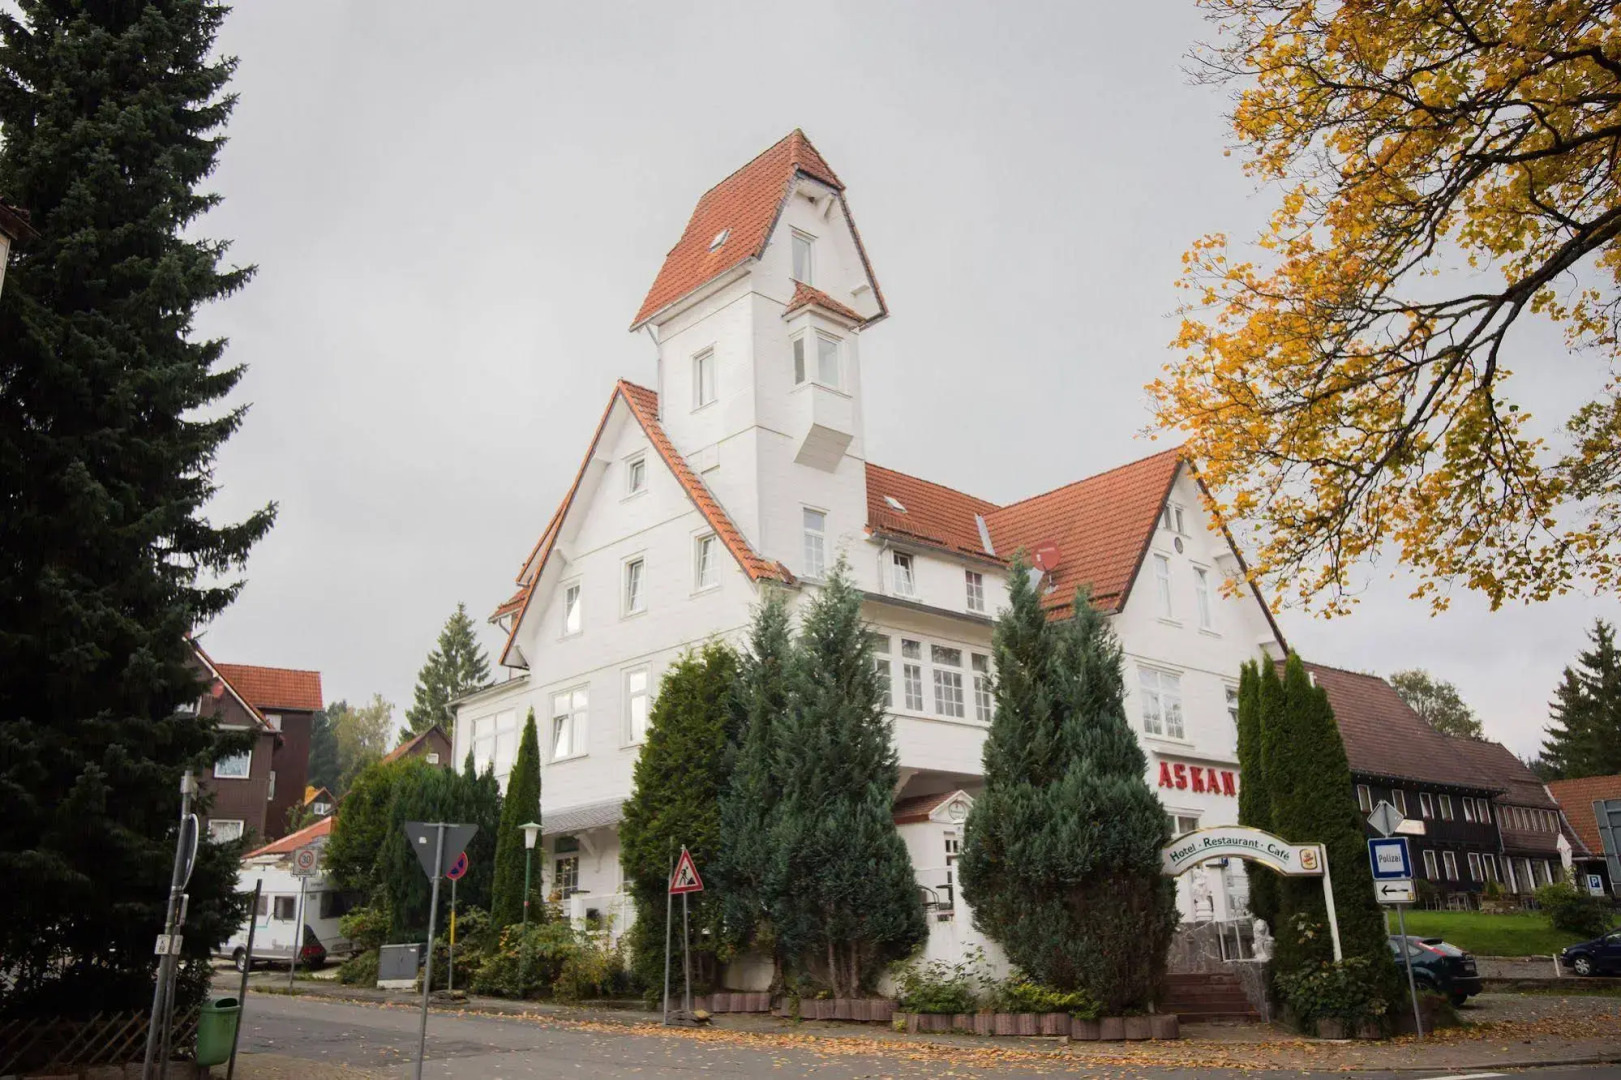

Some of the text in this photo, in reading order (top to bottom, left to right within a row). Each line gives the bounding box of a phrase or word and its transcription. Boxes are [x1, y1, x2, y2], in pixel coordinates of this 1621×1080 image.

[1169, 837, 1290, 861] Hotel Restaurant Café
[302, 855, 311, 864] 30
[1378, 853, 1401, 863] Polizei
[1591, 876, 1598, 887] P
